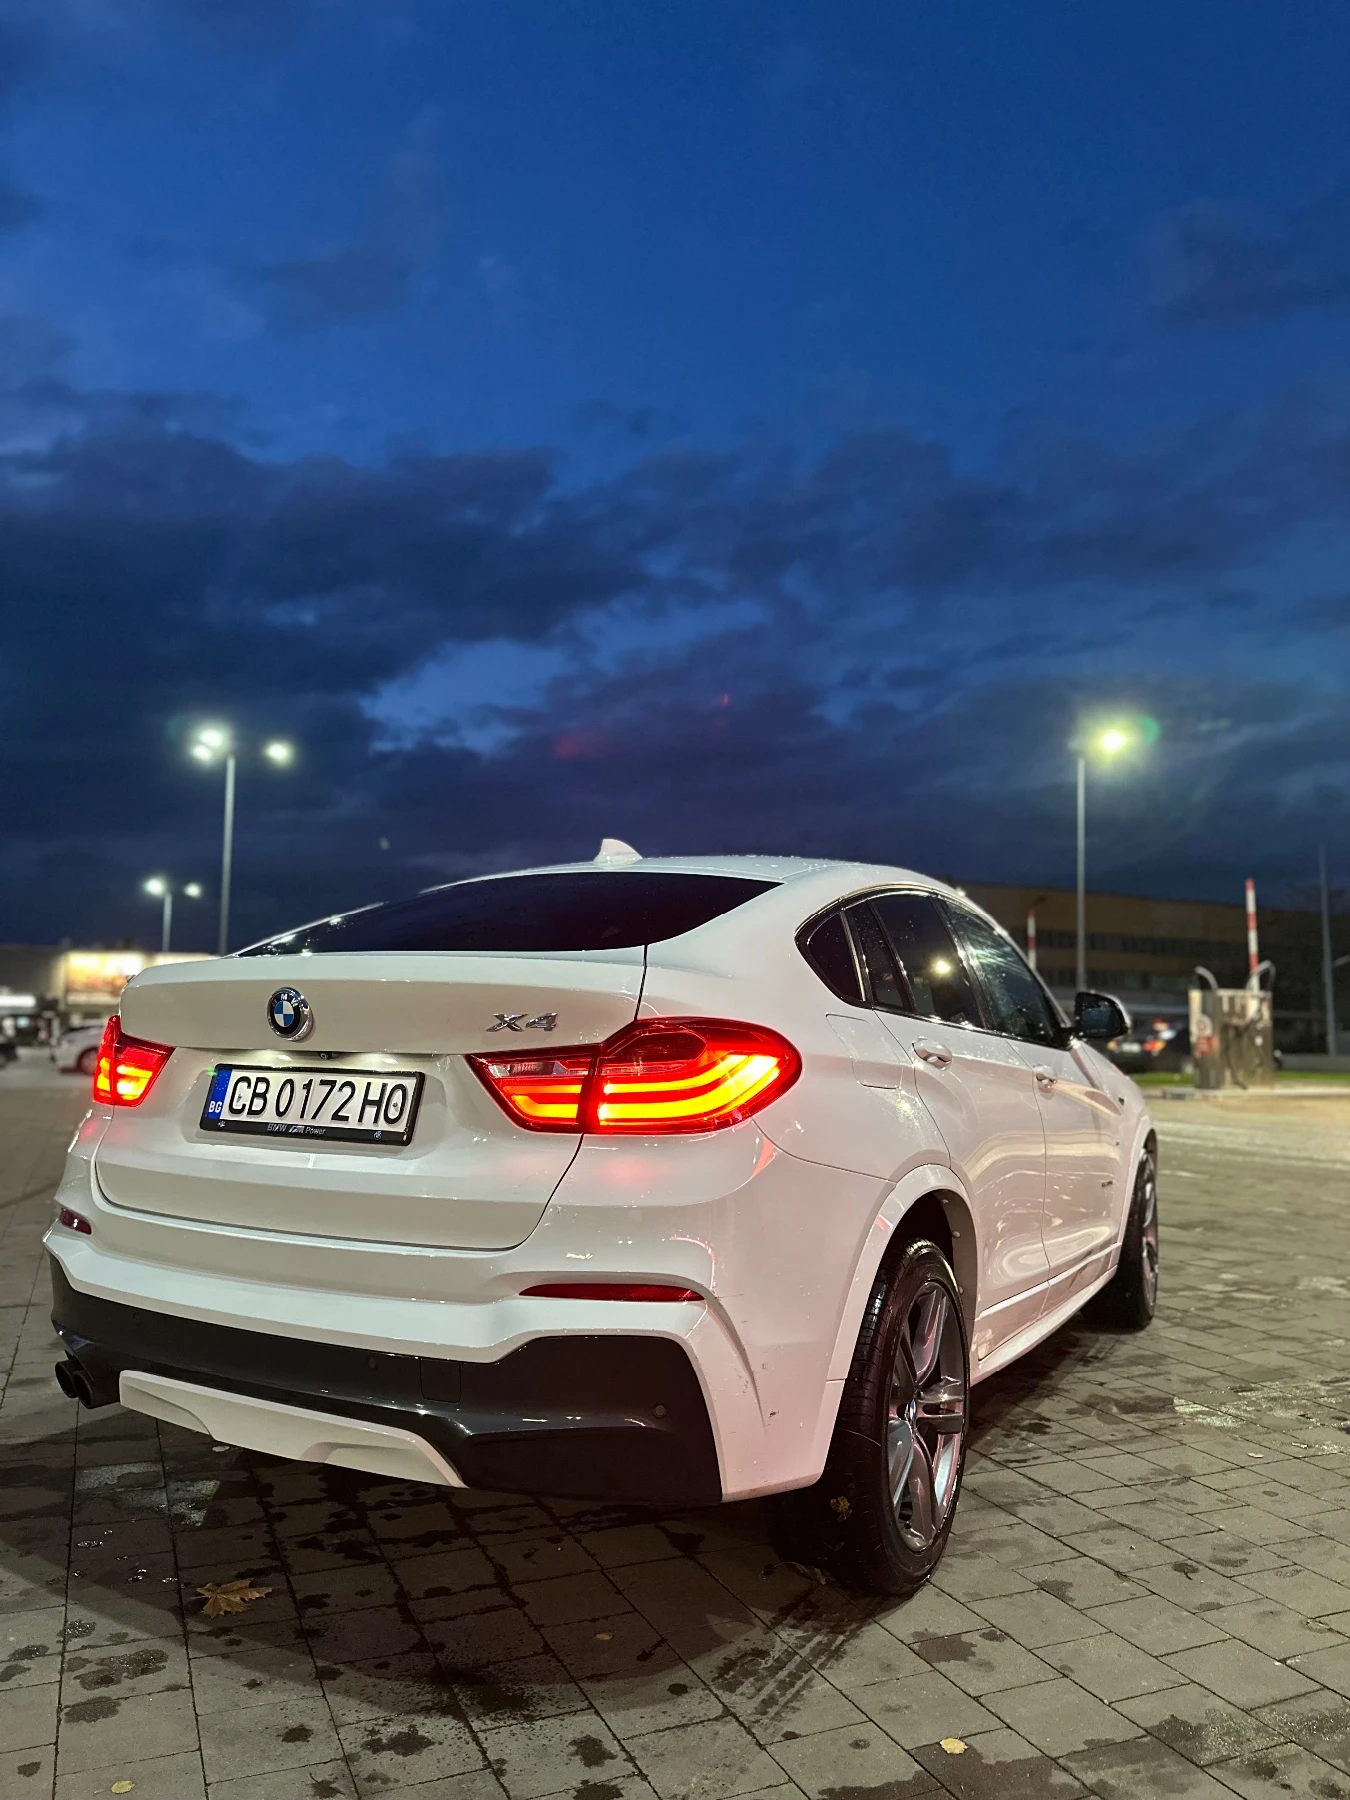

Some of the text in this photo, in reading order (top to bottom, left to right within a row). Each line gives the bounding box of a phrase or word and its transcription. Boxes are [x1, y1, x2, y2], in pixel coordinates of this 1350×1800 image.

[485, 1012, 558, 1032] X4
[208, 1100, 223, 1113] BG
[228, 1075, 271, 1116] CB
[275, 1078, 356, 1122] 0172
[267, 1123, 287, 1132] BMW
[305, 1126, 326, 1135] Power
